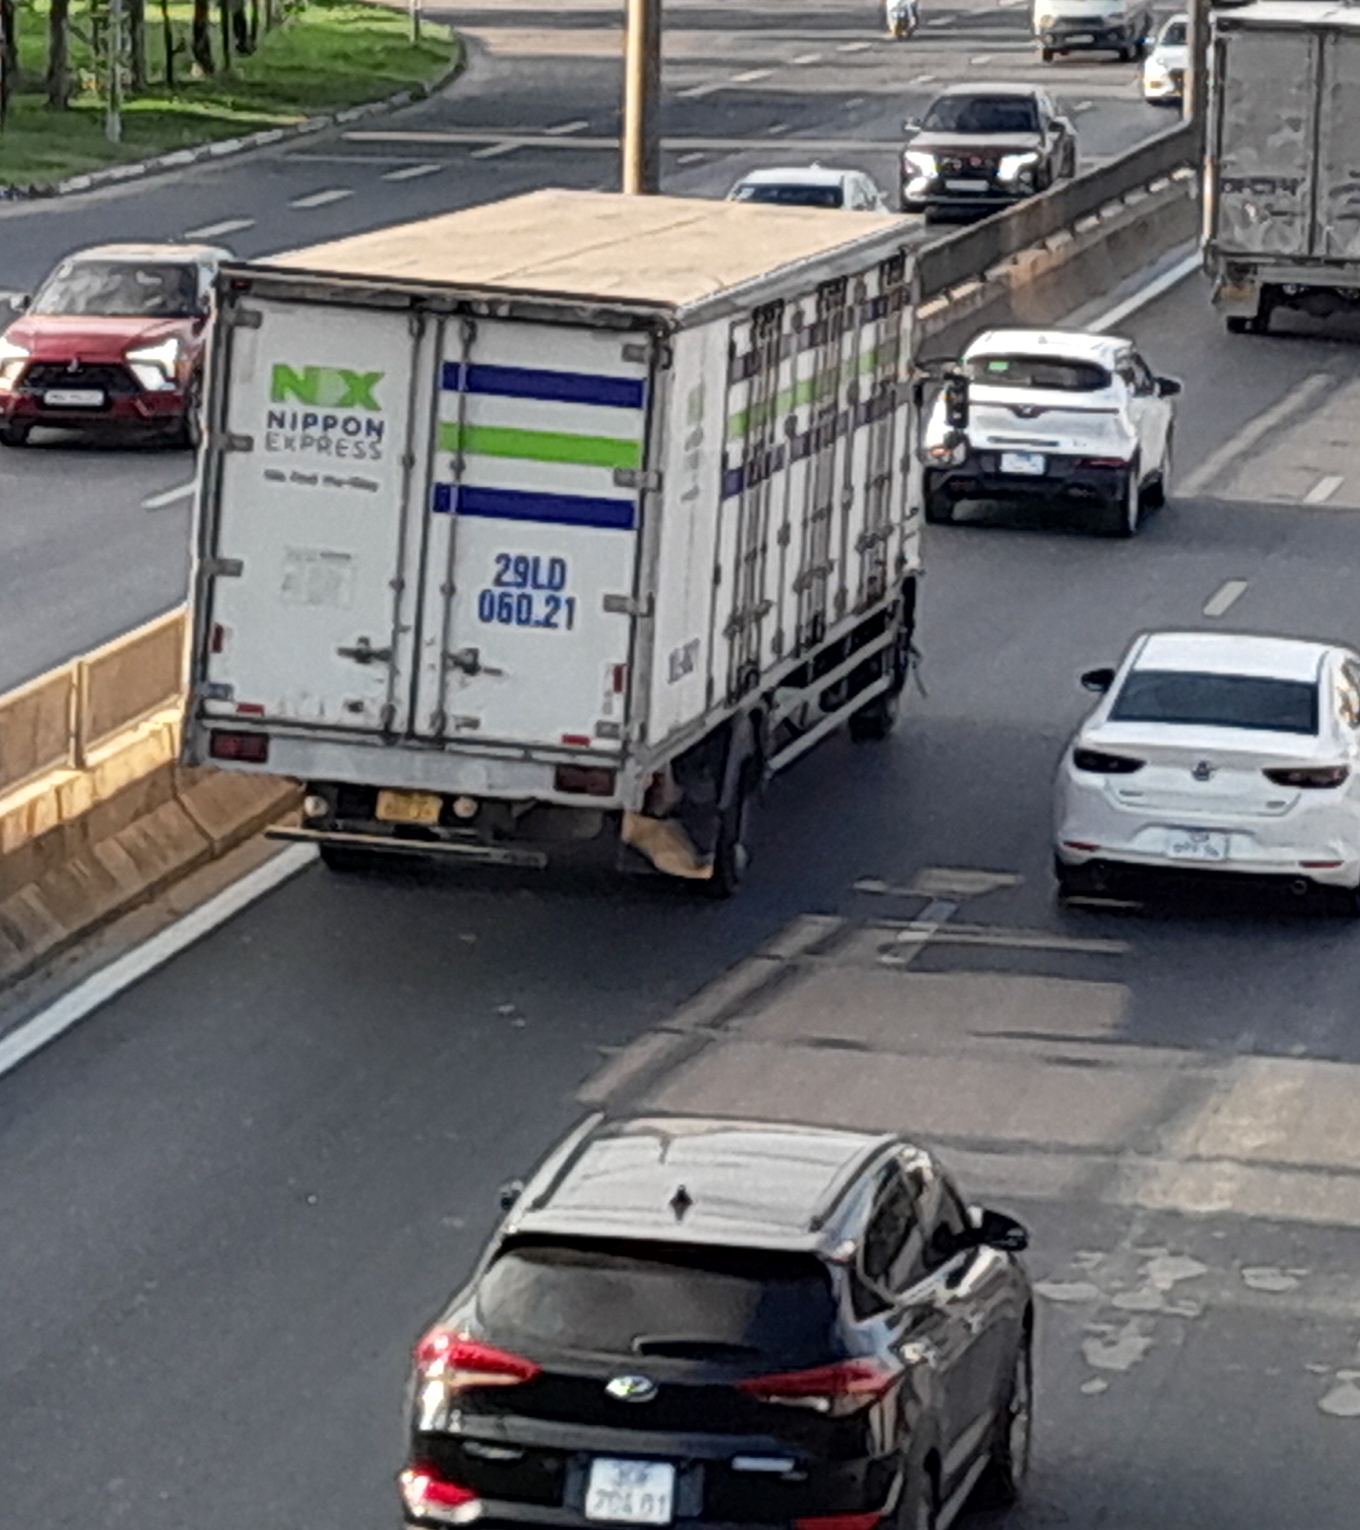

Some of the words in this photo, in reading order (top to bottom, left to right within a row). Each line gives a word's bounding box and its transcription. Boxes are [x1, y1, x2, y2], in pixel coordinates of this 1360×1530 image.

[270, 362, 386, 412] NX
[266, 409, 385, 438] NIPPON
[264, 431, 383, 460] EXPRESS
[492, 552, 567, 592] 29LD
